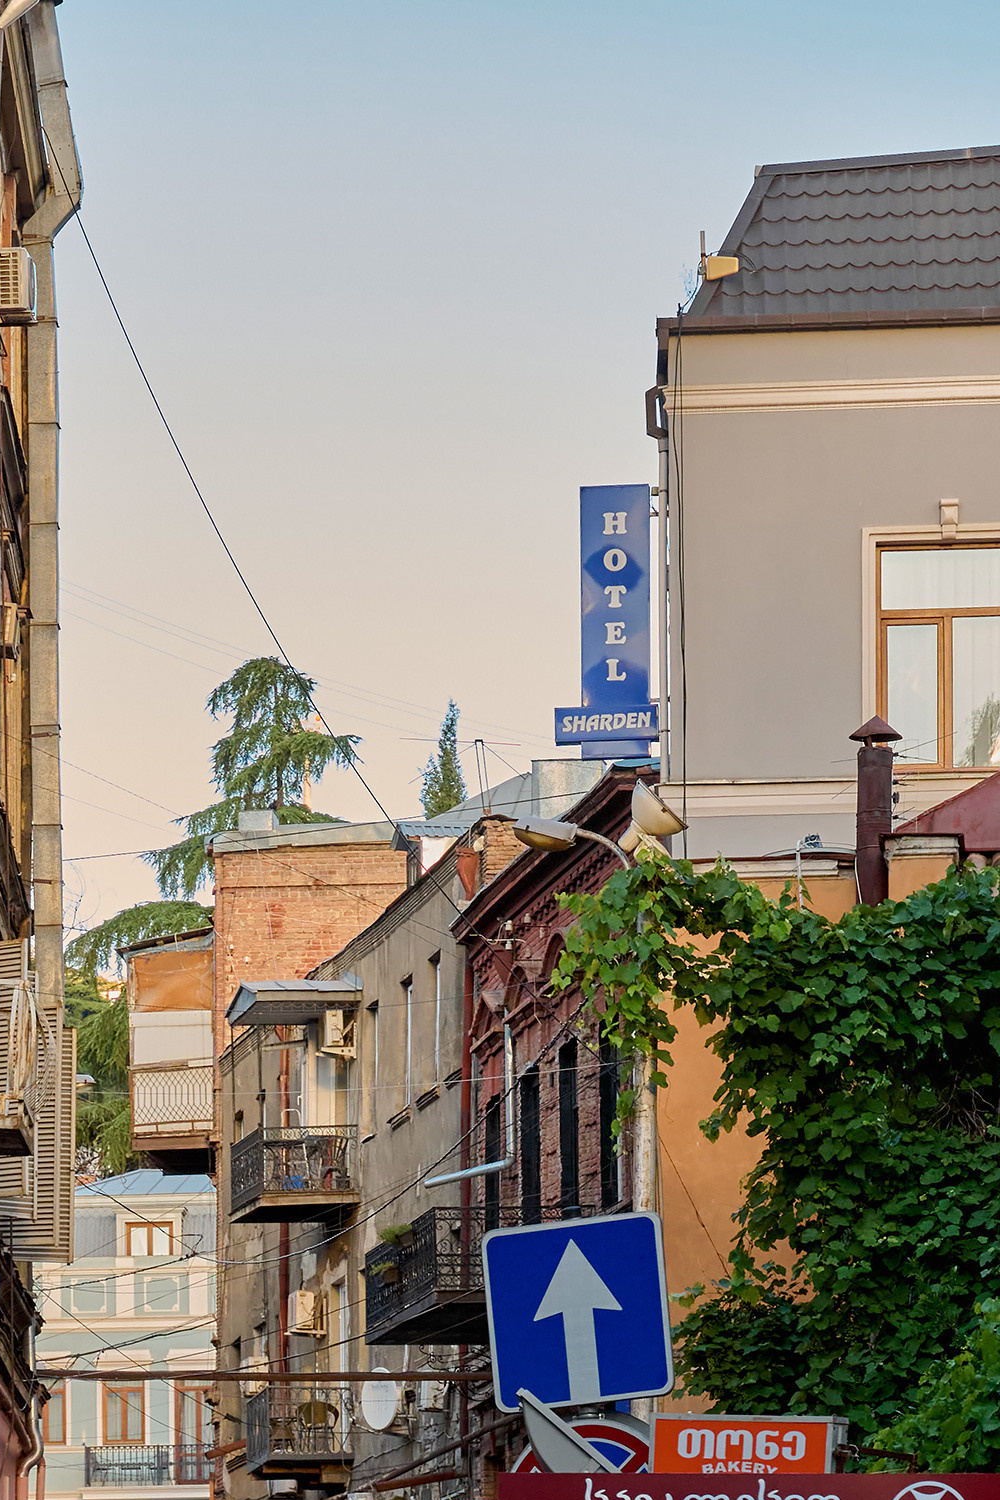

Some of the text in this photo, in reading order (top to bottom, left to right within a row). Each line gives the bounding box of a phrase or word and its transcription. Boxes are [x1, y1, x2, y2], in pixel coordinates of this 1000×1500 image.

[602, 511, 628, 682] HOTEL
[562, 711, 651, 734] SHARDEN
[677, 1427, 807, 1461] თონე
[701, 1460, 779, 1474] BAKERY
